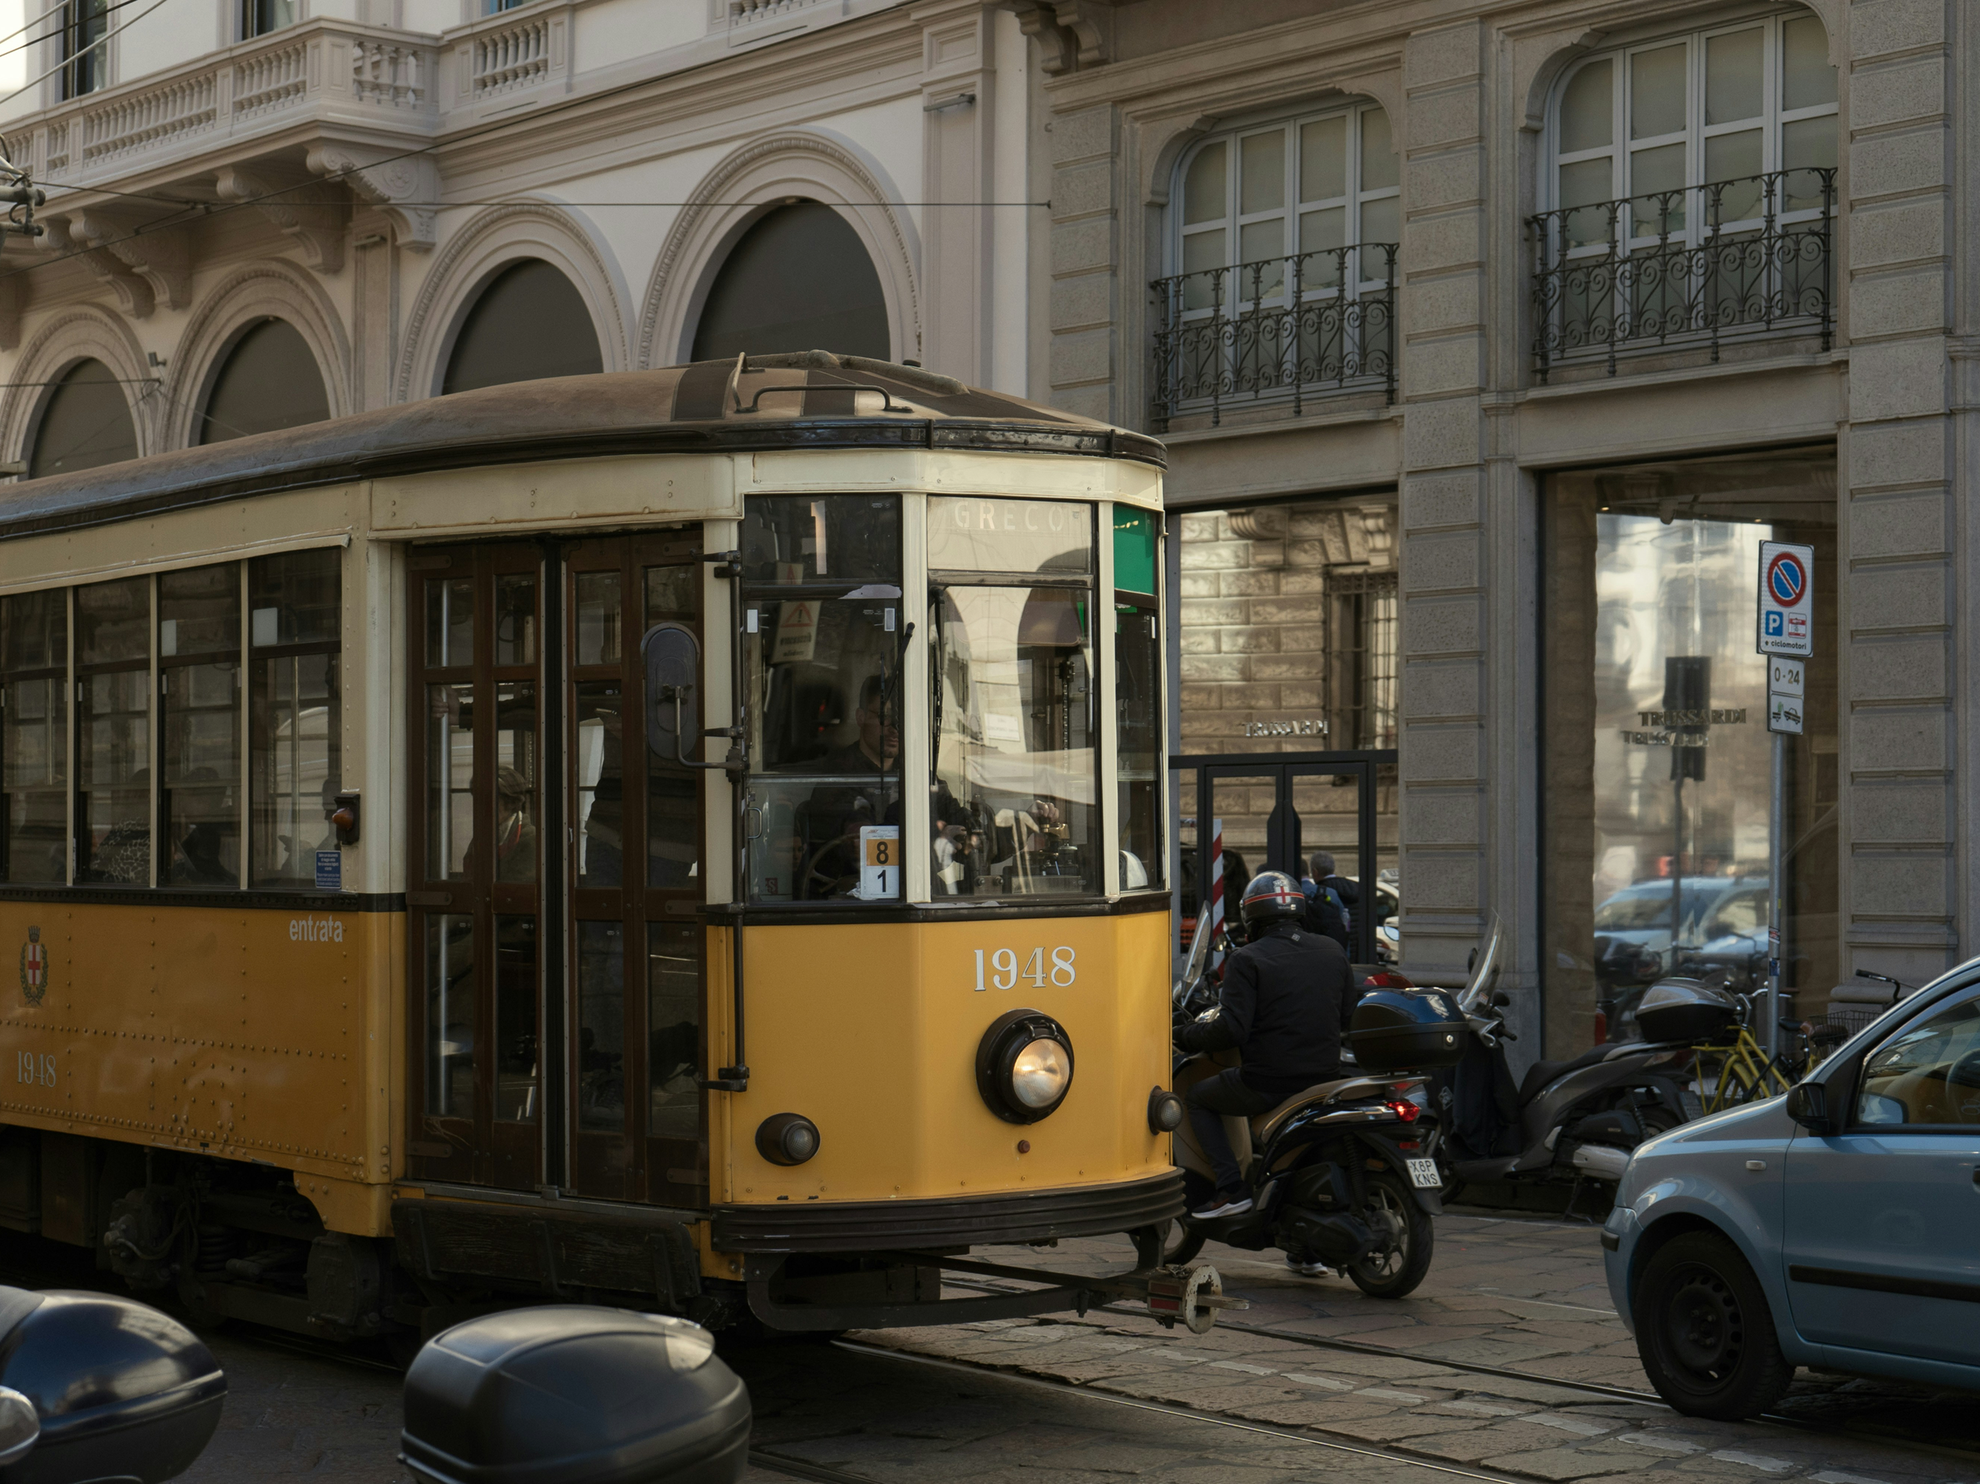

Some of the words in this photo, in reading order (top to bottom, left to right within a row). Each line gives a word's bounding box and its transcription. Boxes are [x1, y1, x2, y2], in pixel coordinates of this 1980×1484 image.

[954, 502, 1064, 532] GRECO
[1769, 614, 1780, 633] P
[1771, 640, 1806, 649] ciclomotori
[1244, 720, 1328, 736] TRUSSARDI
[1638, 708, 1747, 727] TRUSSARDI
[876, 841, 889, 865] 8
[877, 869, 887, 893] 1
[289, 914, 343, 942] entrata
[974, 946, 1076, 992] 1948
[17, 1050, 57, 1088] 1948
[1410, 1160, 1432, 1173] X8P
[1415, 1173, 1438, 1186] KNS
